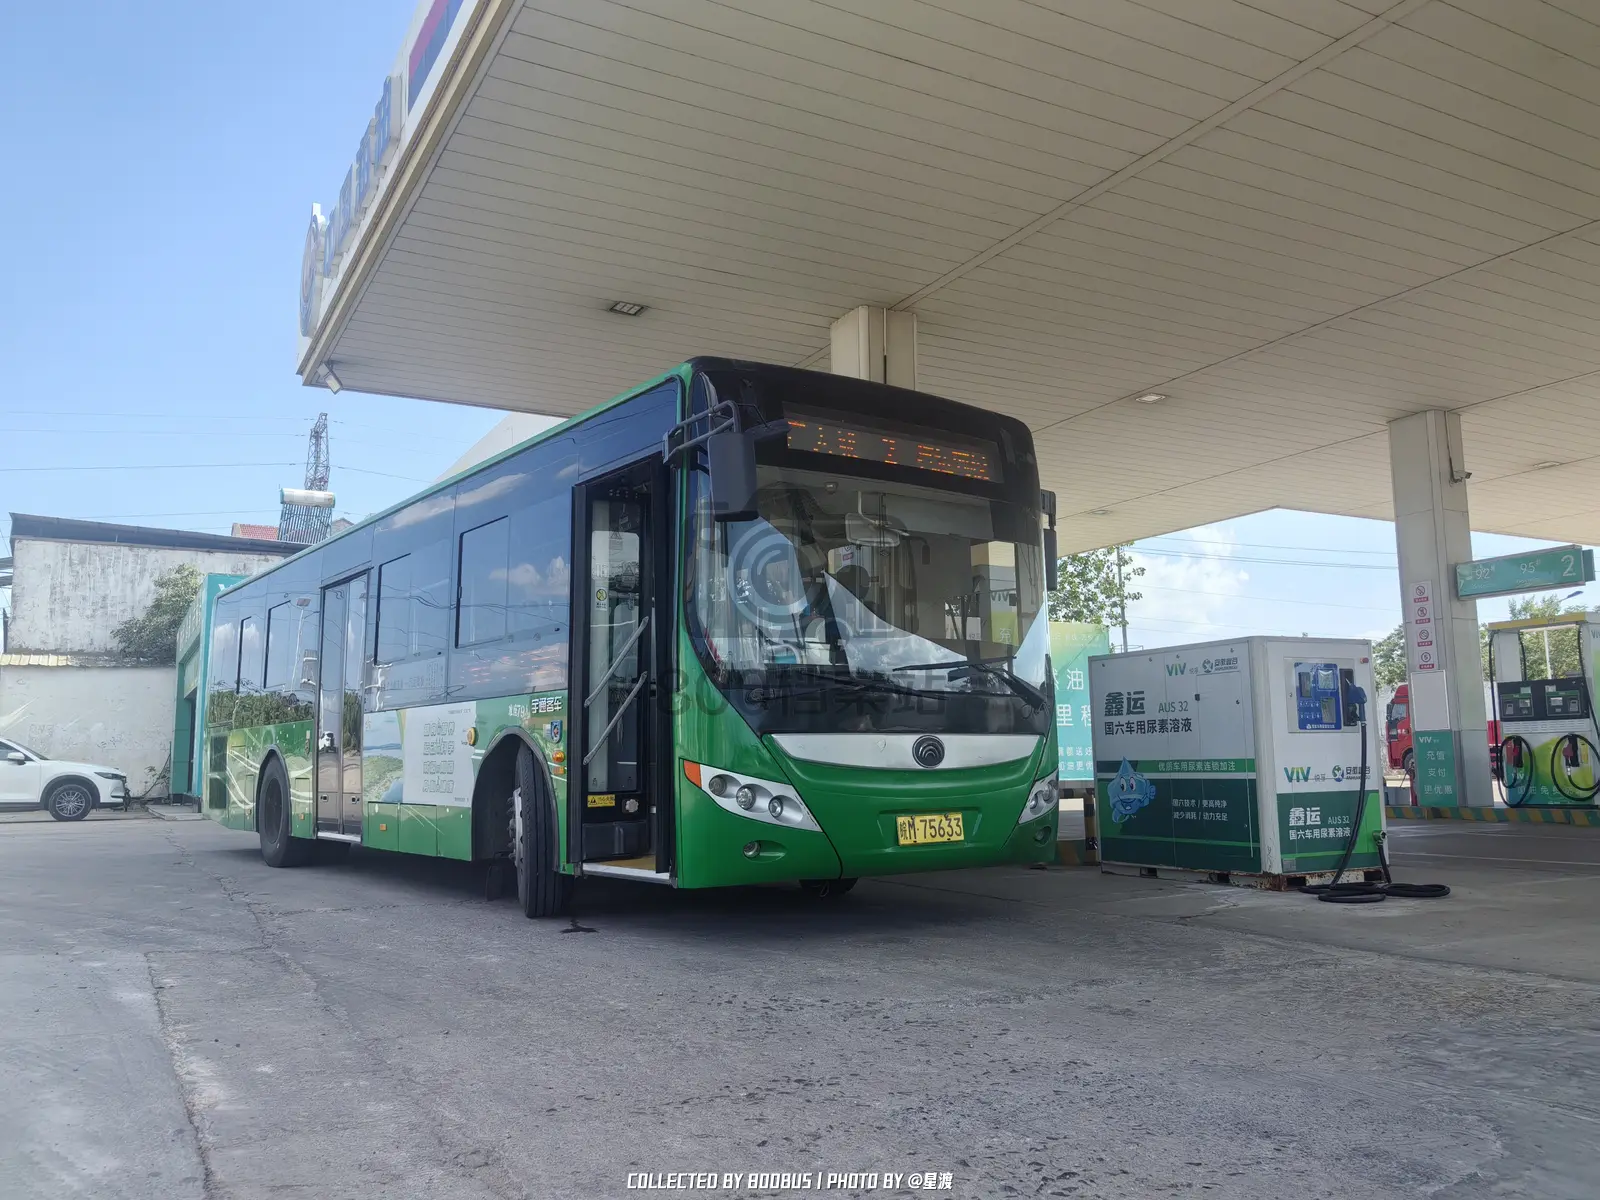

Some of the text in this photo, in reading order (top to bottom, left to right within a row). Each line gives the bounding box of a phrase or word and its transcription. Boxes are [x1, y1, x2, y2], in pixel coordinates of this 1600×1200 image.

[1561, 555, 1576, 576] 2
[1166, 662, 1187, 676] VIV
[532, 696, 563, 714] 宇通客车
[1104, 691, 1146, 717] 鑫运
[1158, 701, 1189, 713] AUS 32
[1104, 717, 1193, 736] 国六车用尿素溶液
[1427, 750, 1445, 760] 充值
[1158, 761, 1236, 772] 优质车用尿素连锁加注
[1428, 767, 1446, 777] 支付
[1283, 766, 1311, 783] VIV
[1424, 785, 1453, 795] 更优惠
[1289, 806, 1321, 826] 鑫运
[1327, 816, 1350, 824] AUS 32
[1289, 827, 1351, 840] 国六车用尿素溶液
